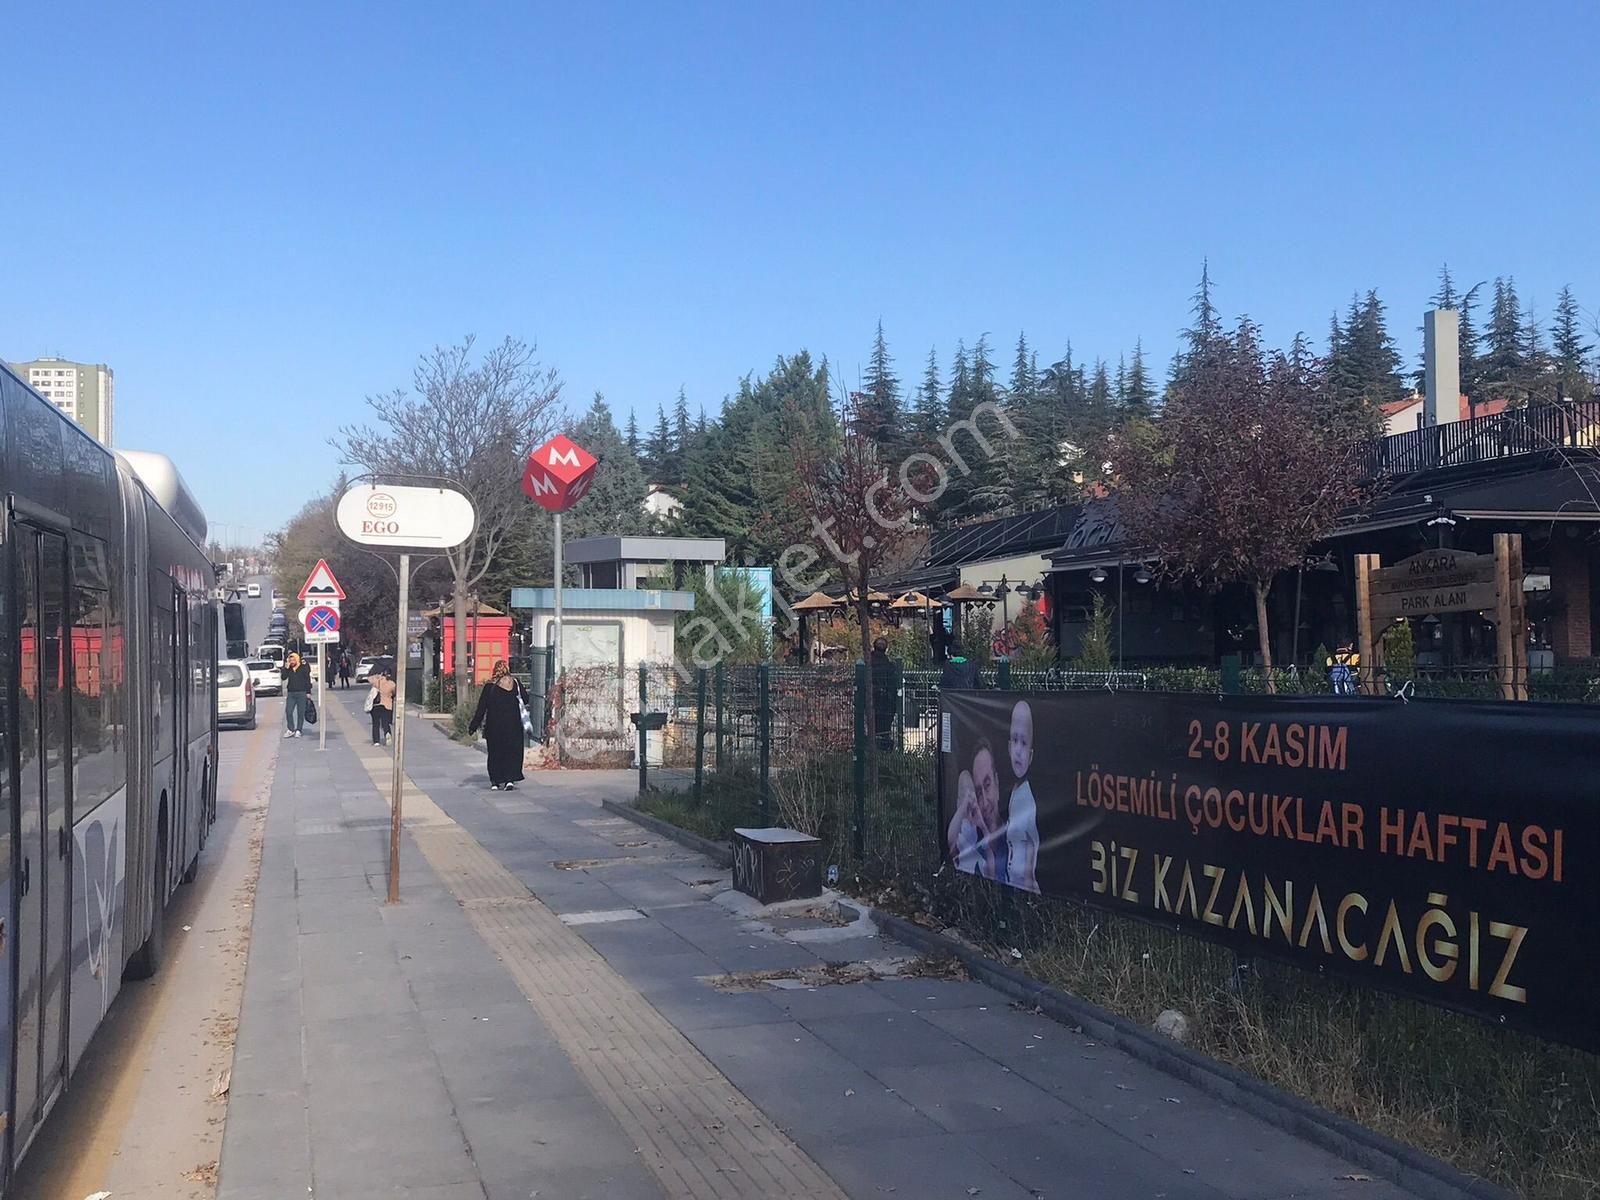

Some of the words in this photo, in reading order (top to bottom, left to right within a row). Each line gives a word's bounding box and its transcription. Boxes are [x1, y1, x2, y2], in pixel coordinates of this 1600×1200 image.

[549, 446, 581, 467] M
[530, 472, 559, 496] M
[369, 501, 393, 511] 12915
[361, 520, 400, 534] EGO
[1409, 556, 1457, 573] ANKARA
[1401, 595, 1430, 610] PARK
[1434, 592, 1467, 607] ALANI
[1187, 719, 1230, 761] 2-8
[1241, 721, 1348, 770] KASIM
[1076, 764, 1177, 821] LÖSEMİLİ
[1184, 785, 1365, 850] ÇOCUKLAR
[1380, 806, 1563, 882] HAFTASI
[1154, 853, 1528, 1003] KAZANACAĞIZ
